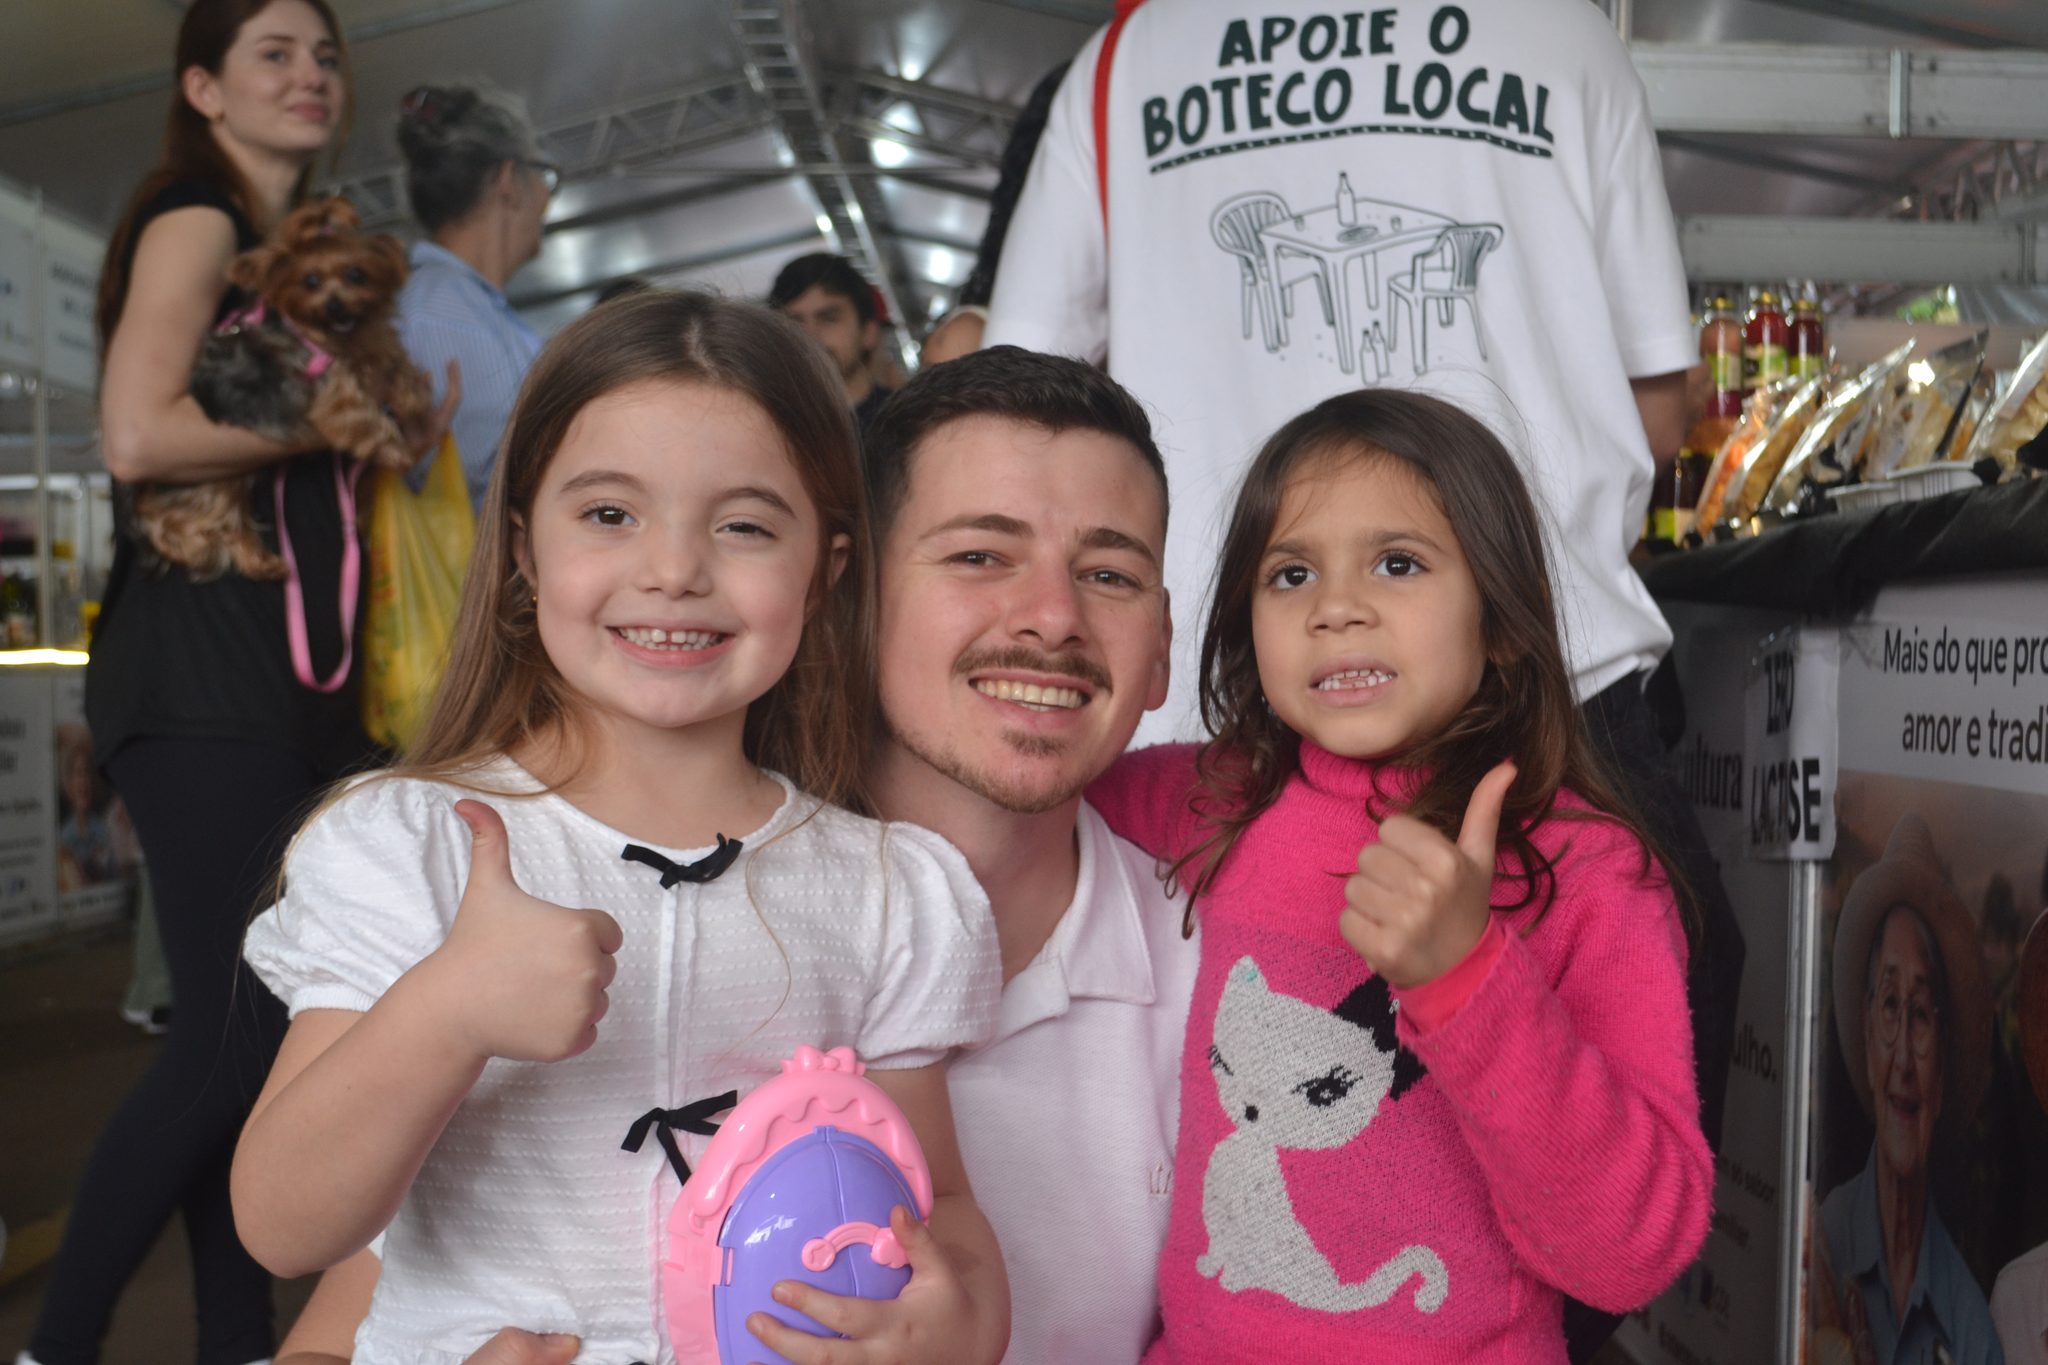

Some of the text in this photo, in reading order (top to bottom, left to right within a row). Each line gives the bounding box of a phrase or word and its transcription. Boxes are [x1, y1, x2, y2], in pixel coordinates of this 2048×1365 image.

[1218, 6, 1469, 67] APOIE O
[1143, 63, 1554, 157] BOTECO LOCAL
[1883, 625, 1929, 673] Mais
[1933, 625, 1960, 673] do
[1965, 637, 2008, 686] que
[1902, 712, 1962, 755] amor
[1966, 716, 1981, 757] e
[1750, 758, 1821, 845] LACTOSE
